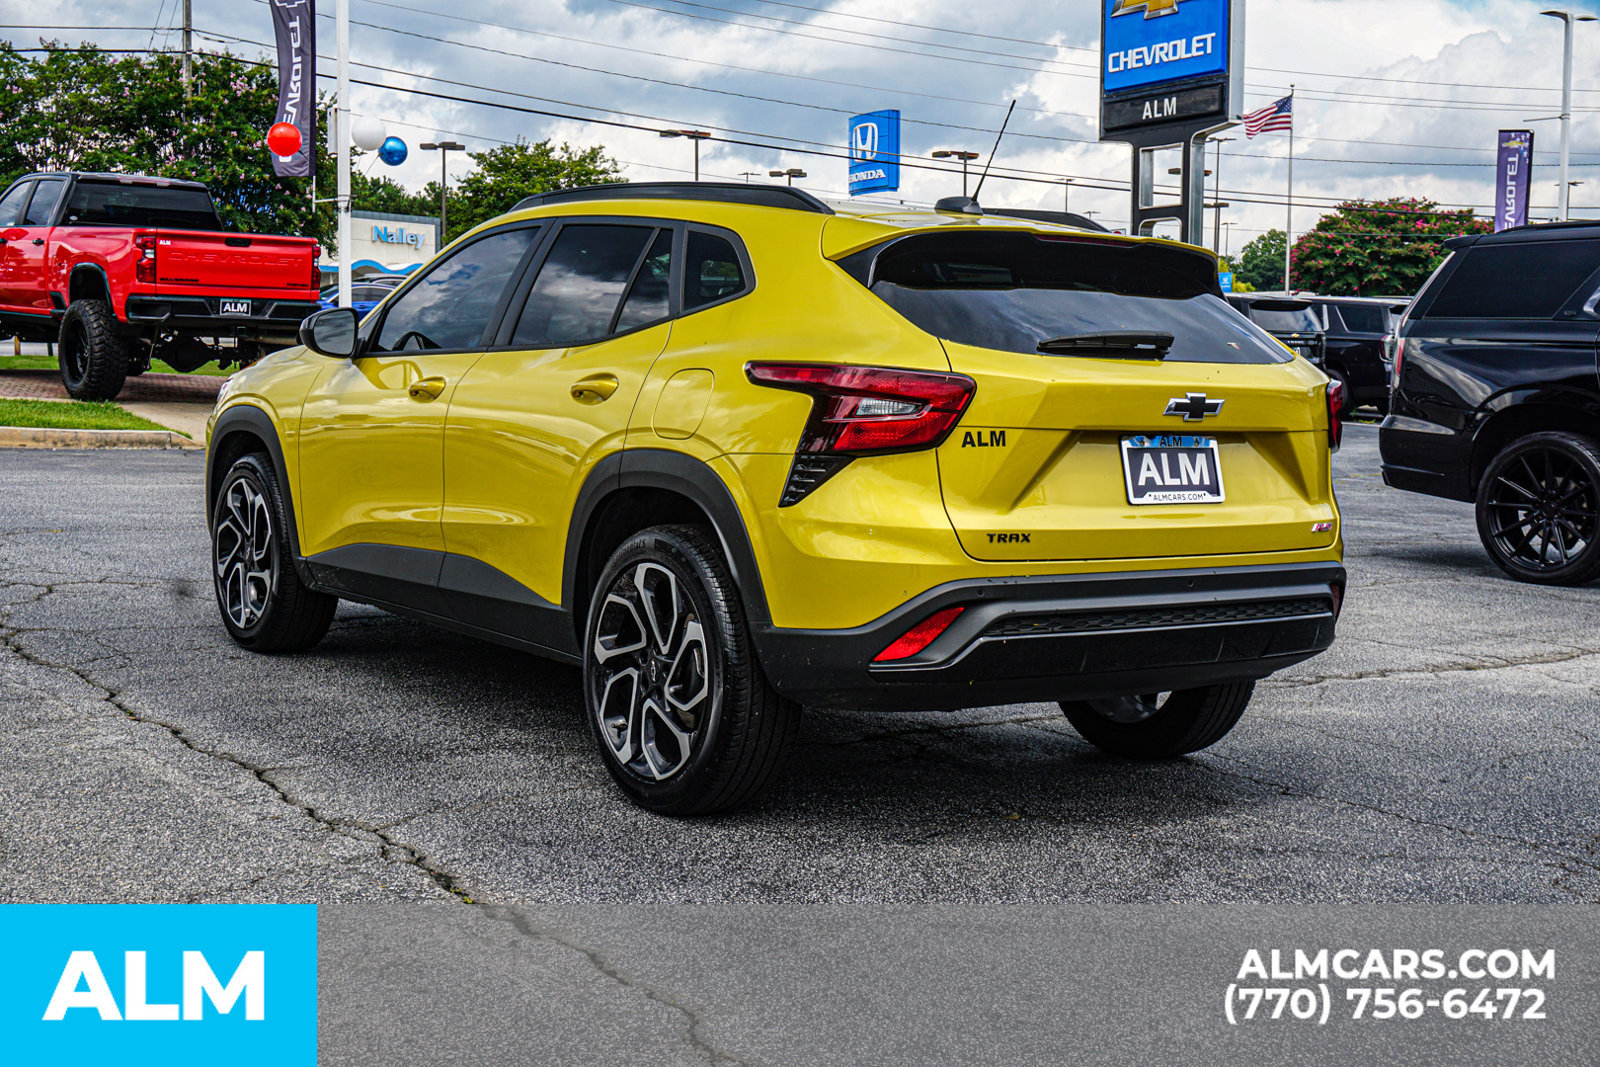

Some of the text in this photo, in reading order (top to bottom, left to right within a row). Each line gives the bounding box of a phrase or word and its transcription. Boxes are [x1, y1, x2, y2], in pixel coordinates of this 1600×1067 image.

[1108, 32, 1216, 73] CHEVROLET
[1142, 96, 1177, 120] ALM
[848, 168, 886, 183] HONDA
[372, 225, 425, 249] Nalley
[223, 302, 248, 312] ALM
[961, 430, 1007, 448] ALM
[1159, 435, 1183, 447] ALM
[1137, 452, 1211, 486] ALM
[1153, 492, 1204, 502] ALMCARS.COM
[987, 533, 1031, 544] TRAX
